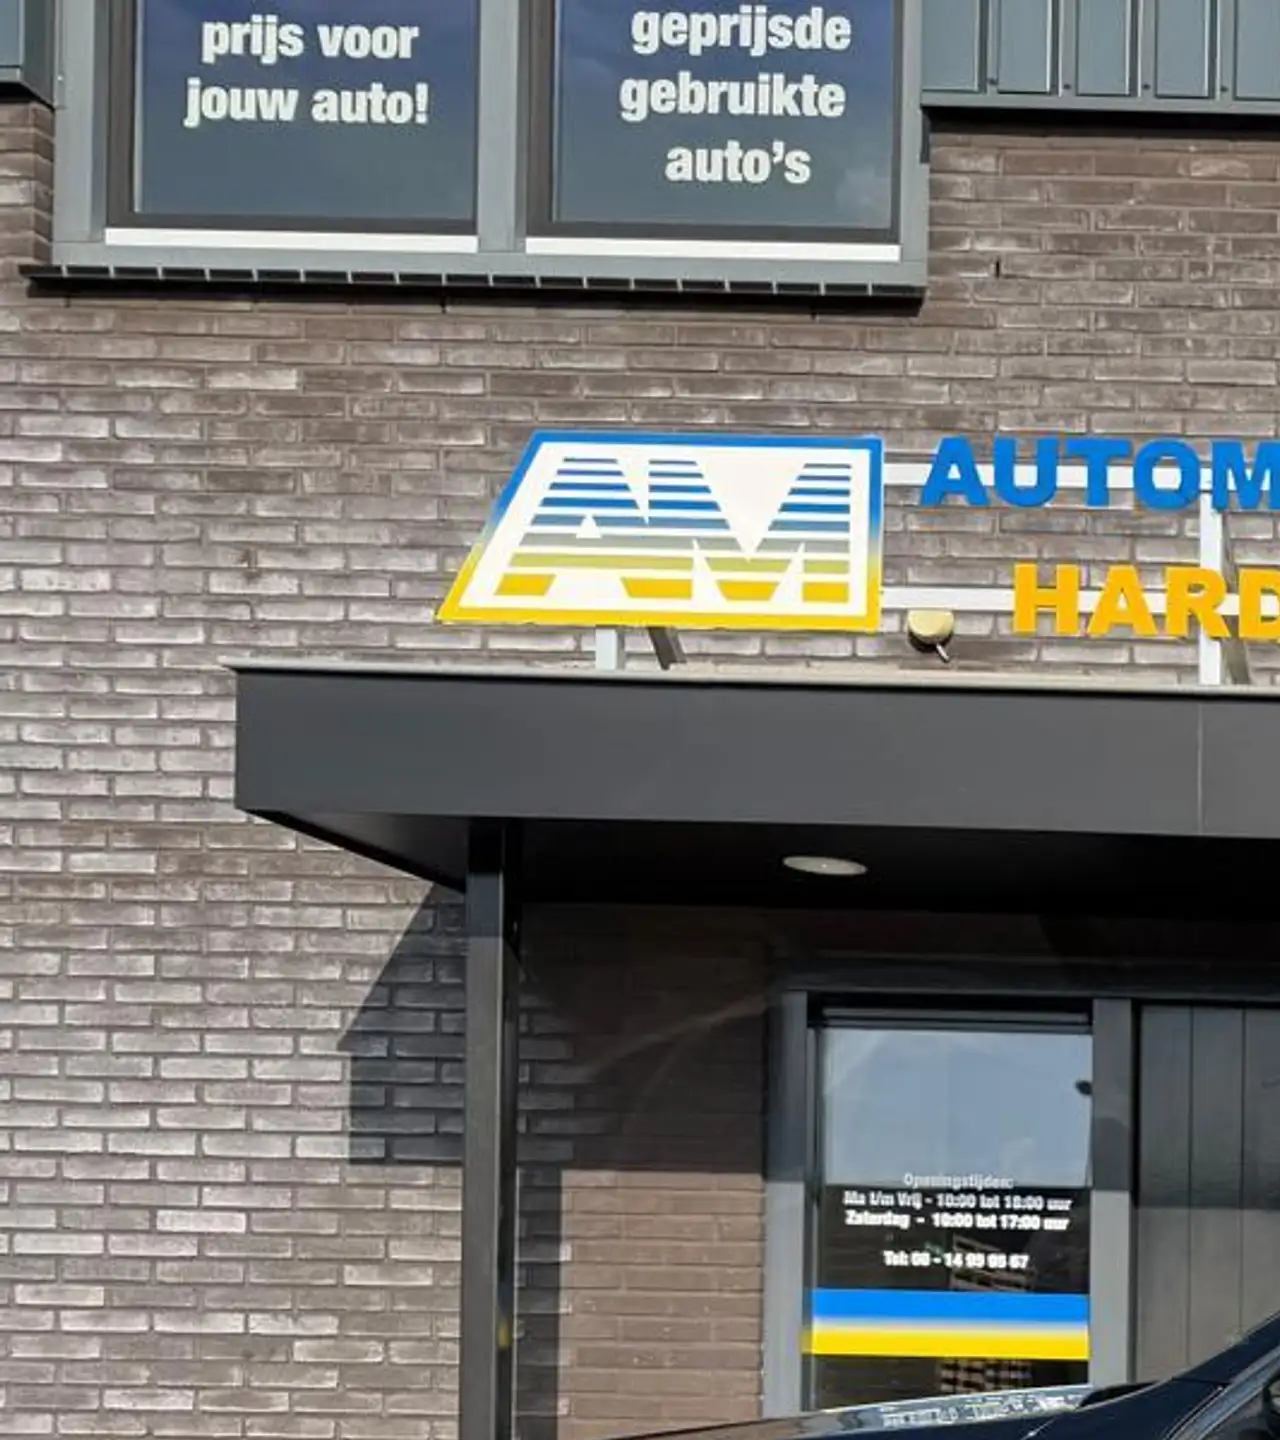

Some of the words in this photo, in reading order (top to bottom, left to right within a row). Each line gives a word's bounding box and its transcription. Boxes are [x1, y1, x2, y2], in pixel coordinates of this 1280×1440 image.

[202, 14, 304, 63] prijs
[317, 24, 419, 59] voor
[631, 4, 852, 57] geprijsde
[183, 77, 299, 128] jouw
[311, 82, 429, 124] auto!
[619, 70, 846, 121] gebruikte
[845, 1209, 910, 1230] Zaterdag
[980, 1194, 1000, 1208] tot
